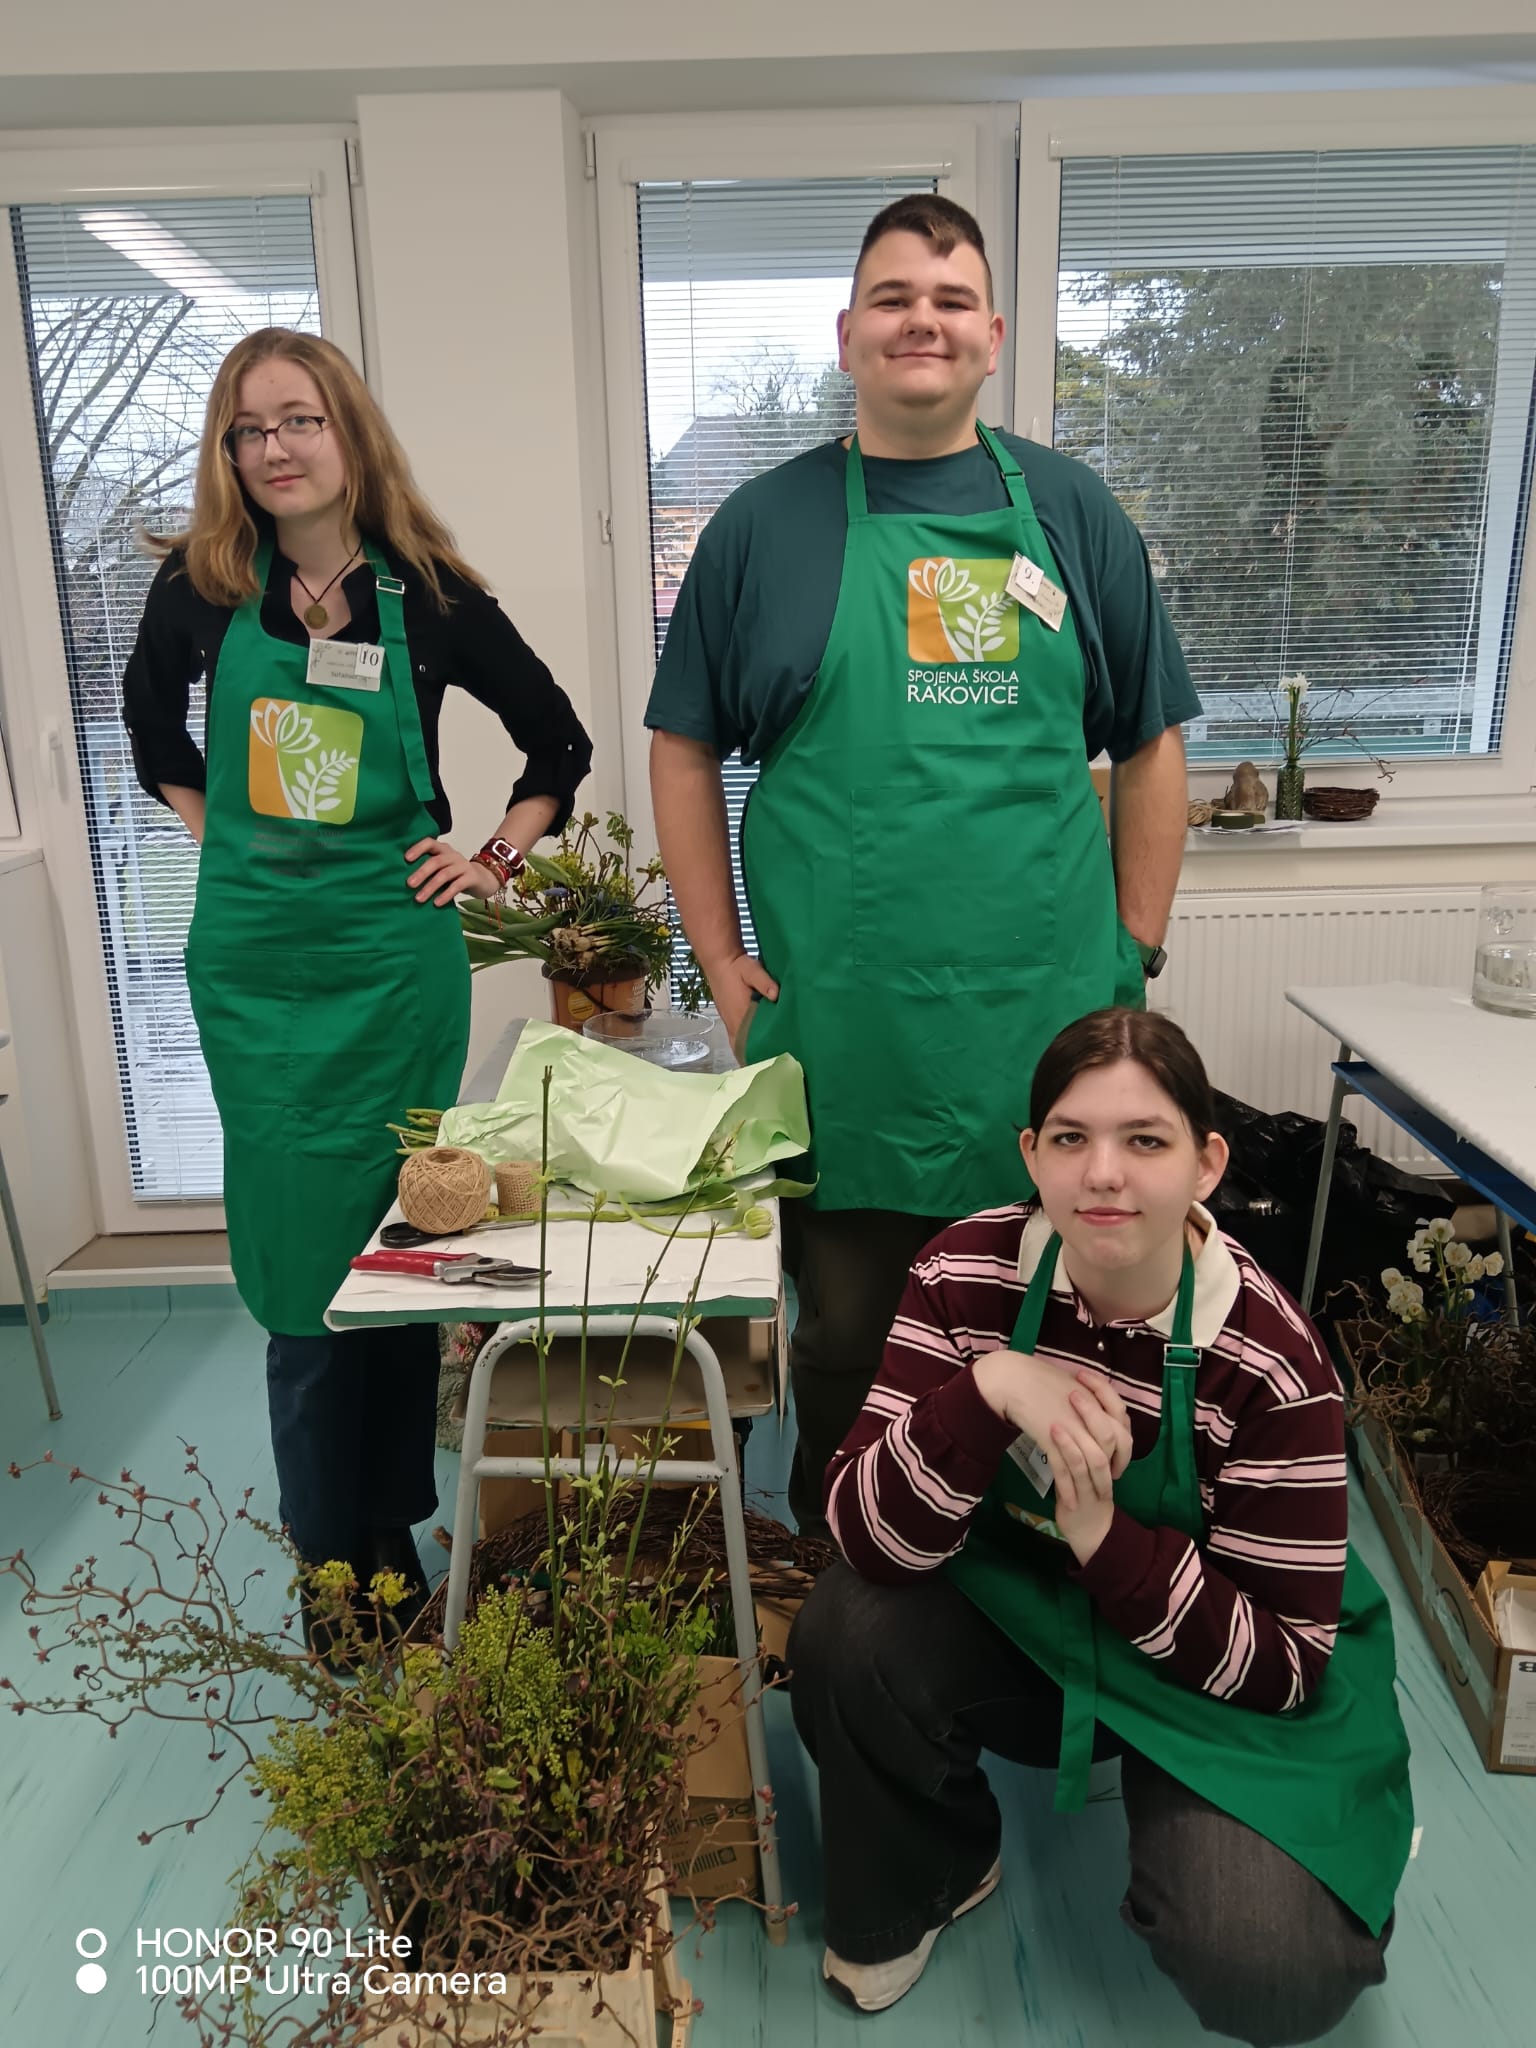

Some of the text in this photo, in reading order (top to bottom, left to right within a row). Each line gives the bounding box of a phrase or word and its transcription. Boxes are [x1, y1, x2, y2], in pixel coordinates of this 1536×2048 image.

[361, 649, 379, 666] 10
[907, 668, 1019, 687] SPOJENÁ ŠKOLA
[907, 684, 1019, 705] RAKOVICE
